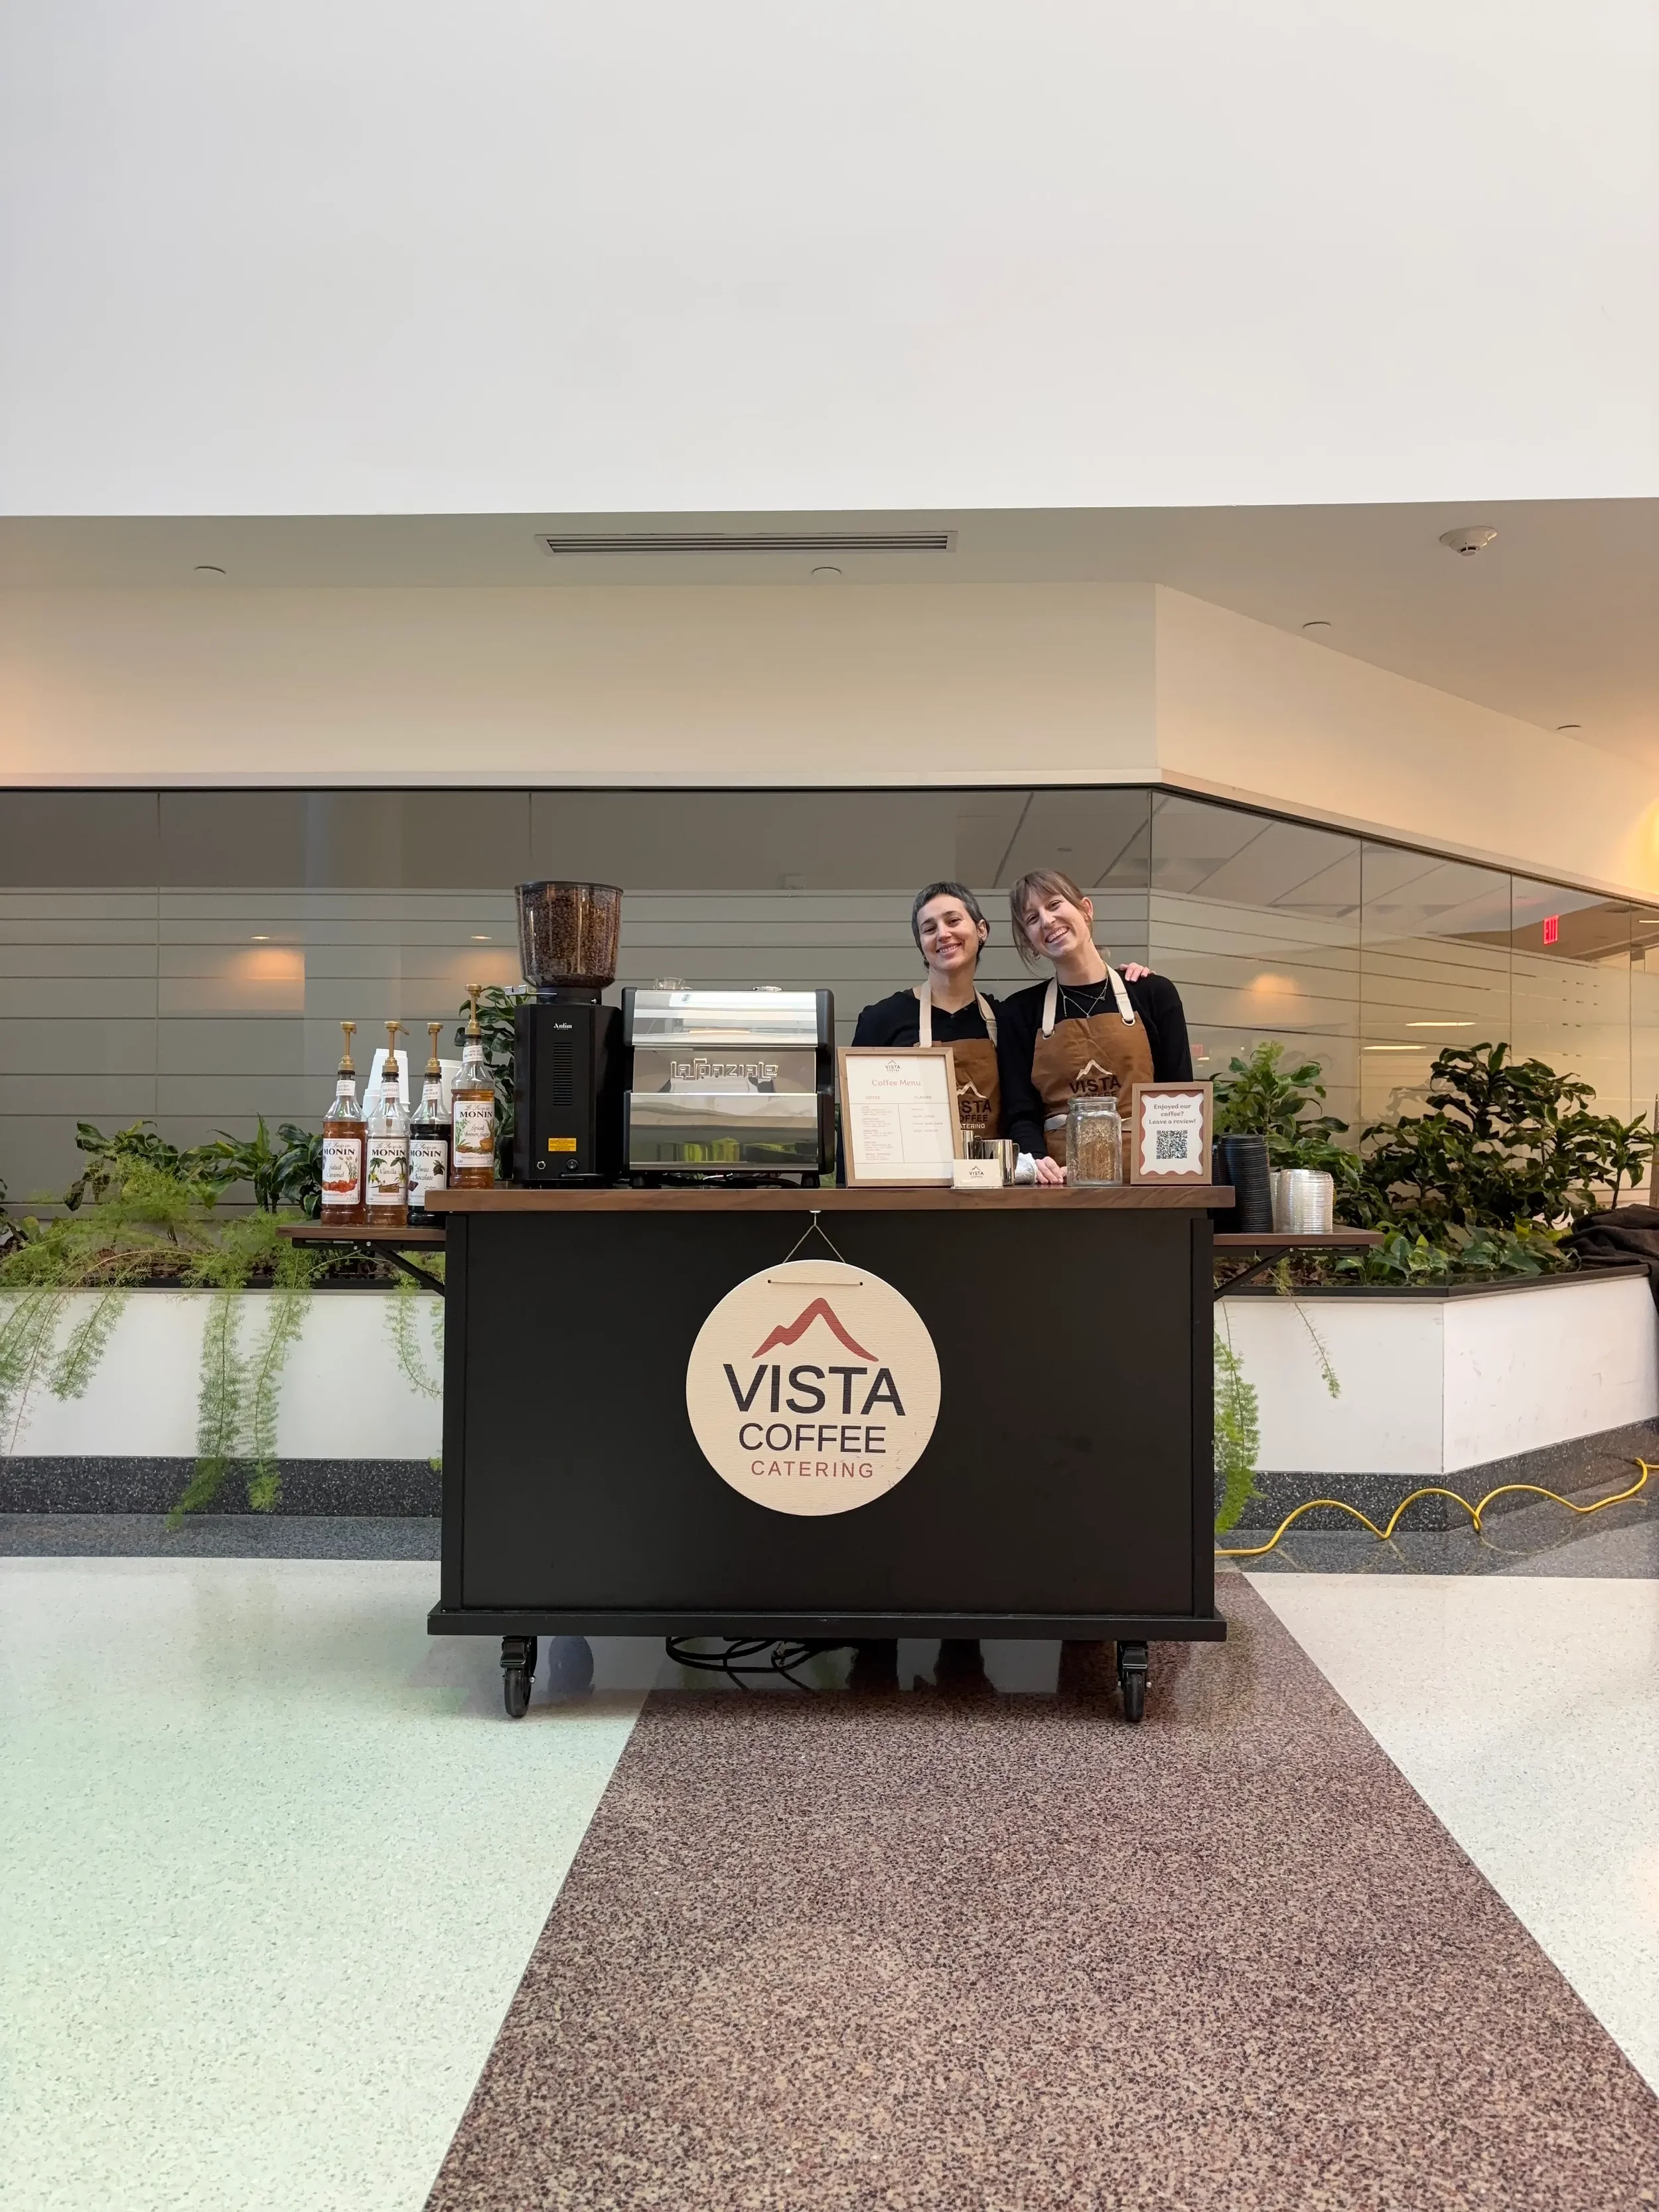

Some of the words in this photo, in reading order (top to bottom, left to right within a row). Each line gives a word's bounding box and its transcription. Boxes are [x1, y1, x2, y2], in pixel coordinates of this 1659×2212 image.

[1069, 1074, 1121, 1094] VISTA
[723, 1363, 906, 1416] VISTA
[739, 1422, 887, 1453] COFFEE
[751, 1459, 874, 1479] CATERING
